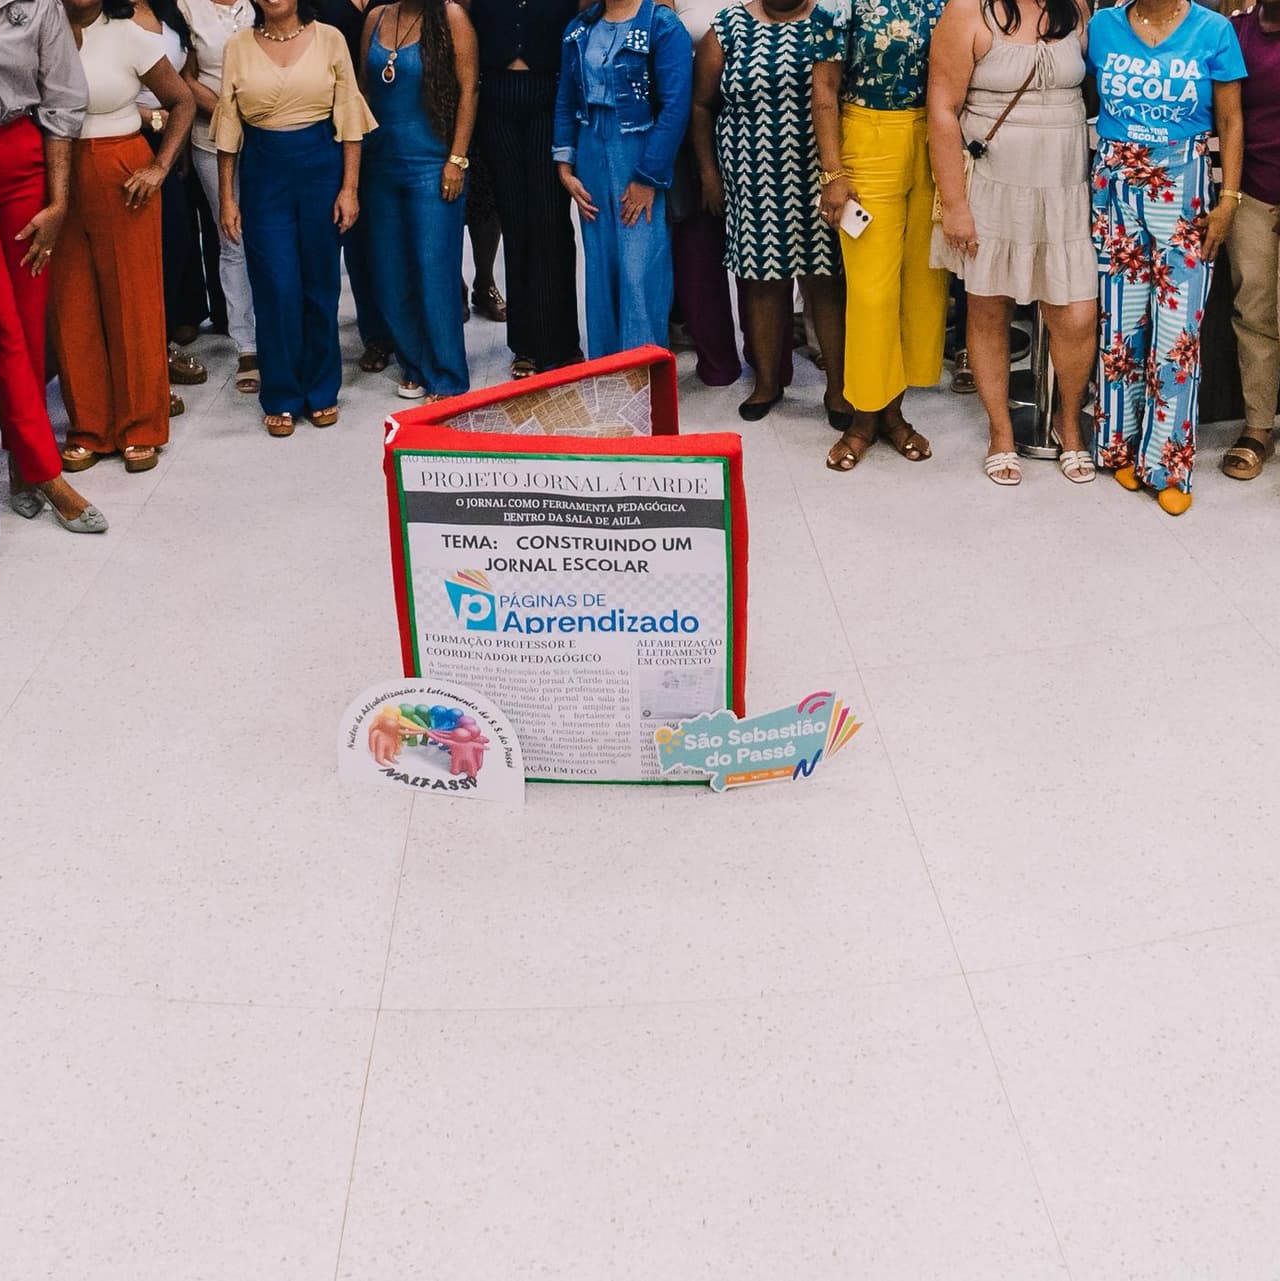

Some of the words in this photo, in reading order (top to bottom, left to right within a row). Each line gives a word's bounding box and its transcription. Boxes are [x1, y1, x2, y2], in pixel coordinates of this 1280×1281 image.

[1104, 52, 1161, 77] FORA
[1170, 58, 1201, 80] DA
[1101, 72, 1199, 103] ESCOLA
[421, 471, 518, 488] PROJETO
[523, 471, 609, 493] JORNAL
[631, 476, 709, 495] TARDE
[456, 498, 464, 507] O
[466, 498, 507, 509] JORNAL
[508, 498, 540, 509] COMO
[542, 499, 614, 513] FERRAMENTA
[617, 500, 686, 512] PEDAGÓGICA
[504, 512, 545, 522] DENTRO
[548, 513, 563, 523] DA
[565, 514, 593, 525] SALA
[595, 516, 609, 525] DE
[611, 516, 641, 526] AULA
[441, 534, 498, 550] TEMA:
[516, 535, 657, 552] CONSTRUINDO
[662, 537, 693, 552] UM
[484, 557, 557, 573] JORNAL
[562, 558, 650, 574] ESCOLAR
[500, 591, 577, 609] PÁGINAS
[584, 594, 607, 607] DE
[503, 608, 700, 634] Aprendizado
[425, 633, 492, 649] FORMAÇÃO
[496, 639, 566, 650] PROFESSOR
[568, 640, 577, 648] E
[637, 638, 723, 648] ALFABETIZAÇÃO
[426, 647, 519, 662] COORDENADOR
[521, 651, 602, 664] PEDAGÓGICO
[646, 648, 717, 657] LETRAMENTO
[655, 656, 711, 665] CONTEXTO
[498, 734, 508, 745] do
[684, 732, 723, 751] São
[728, 719, 826, 745] Sebastião
[705, 753, 732, 768] do
[737, 740, 796, 764] Passé
[524, 764, 551, 773] AÇÃO
[554, 766, 567, 774] EM
